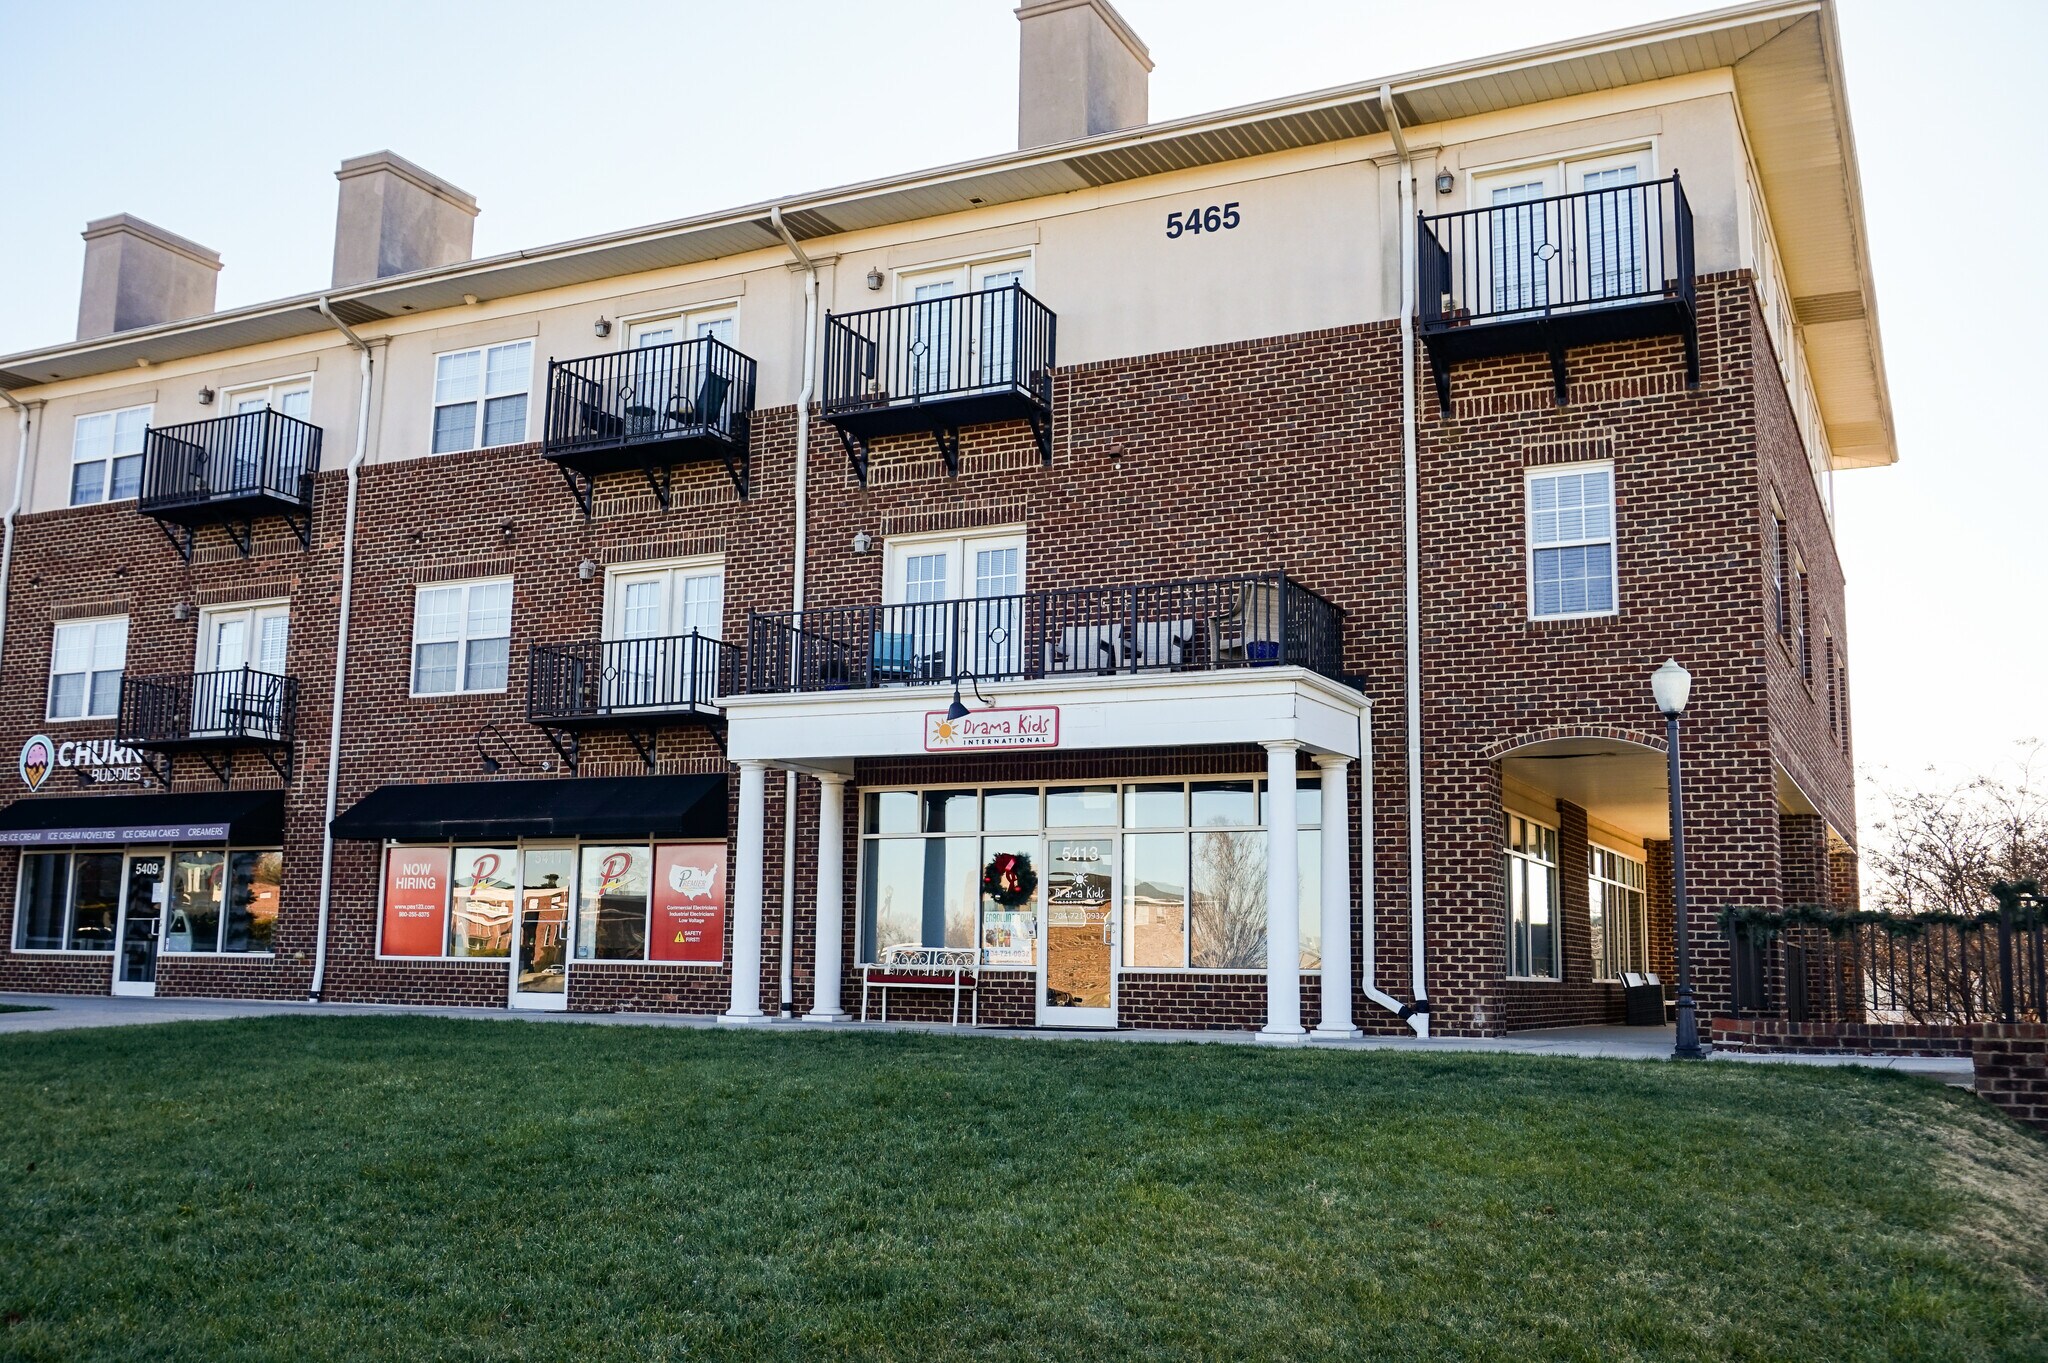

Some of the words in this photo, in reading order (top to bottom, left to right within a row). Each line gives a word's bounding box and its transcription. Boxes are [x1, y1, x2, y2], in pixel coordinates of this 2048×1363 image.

[1166, 202, 1240, 239] 5465
[963, 719, 1010, 735] Drama
[1018, 714, 1049, 734] Kids
[963, 737, 1046, 746] INTERNATIONAL
[58, 738, 144, 767] CHURN
[92, 767, 141, 782] BUDDIES
[19, 832, 41, 841] CREAM
[47, 832, 58, 840] ICE
[59, 831, 81, 840] CREAM
[81, 830, 115, 839] NOVELTIES
[122, 830, 133, 839] ICE
[134, 829, 158, 838] CREAM
[158, 828, 180, 838] CAKES
[187, 827, 223, 837] CREAMERS
[535, 851, 562, 864] 5411
[1062, 846, 1098, 861] 5413
[135, 863, 158, 875] 5409
[402, 863, 431, 875] NOW
[395, 877, 436, 890] HIRING
[1086, 885, 1105, 898] Kids
